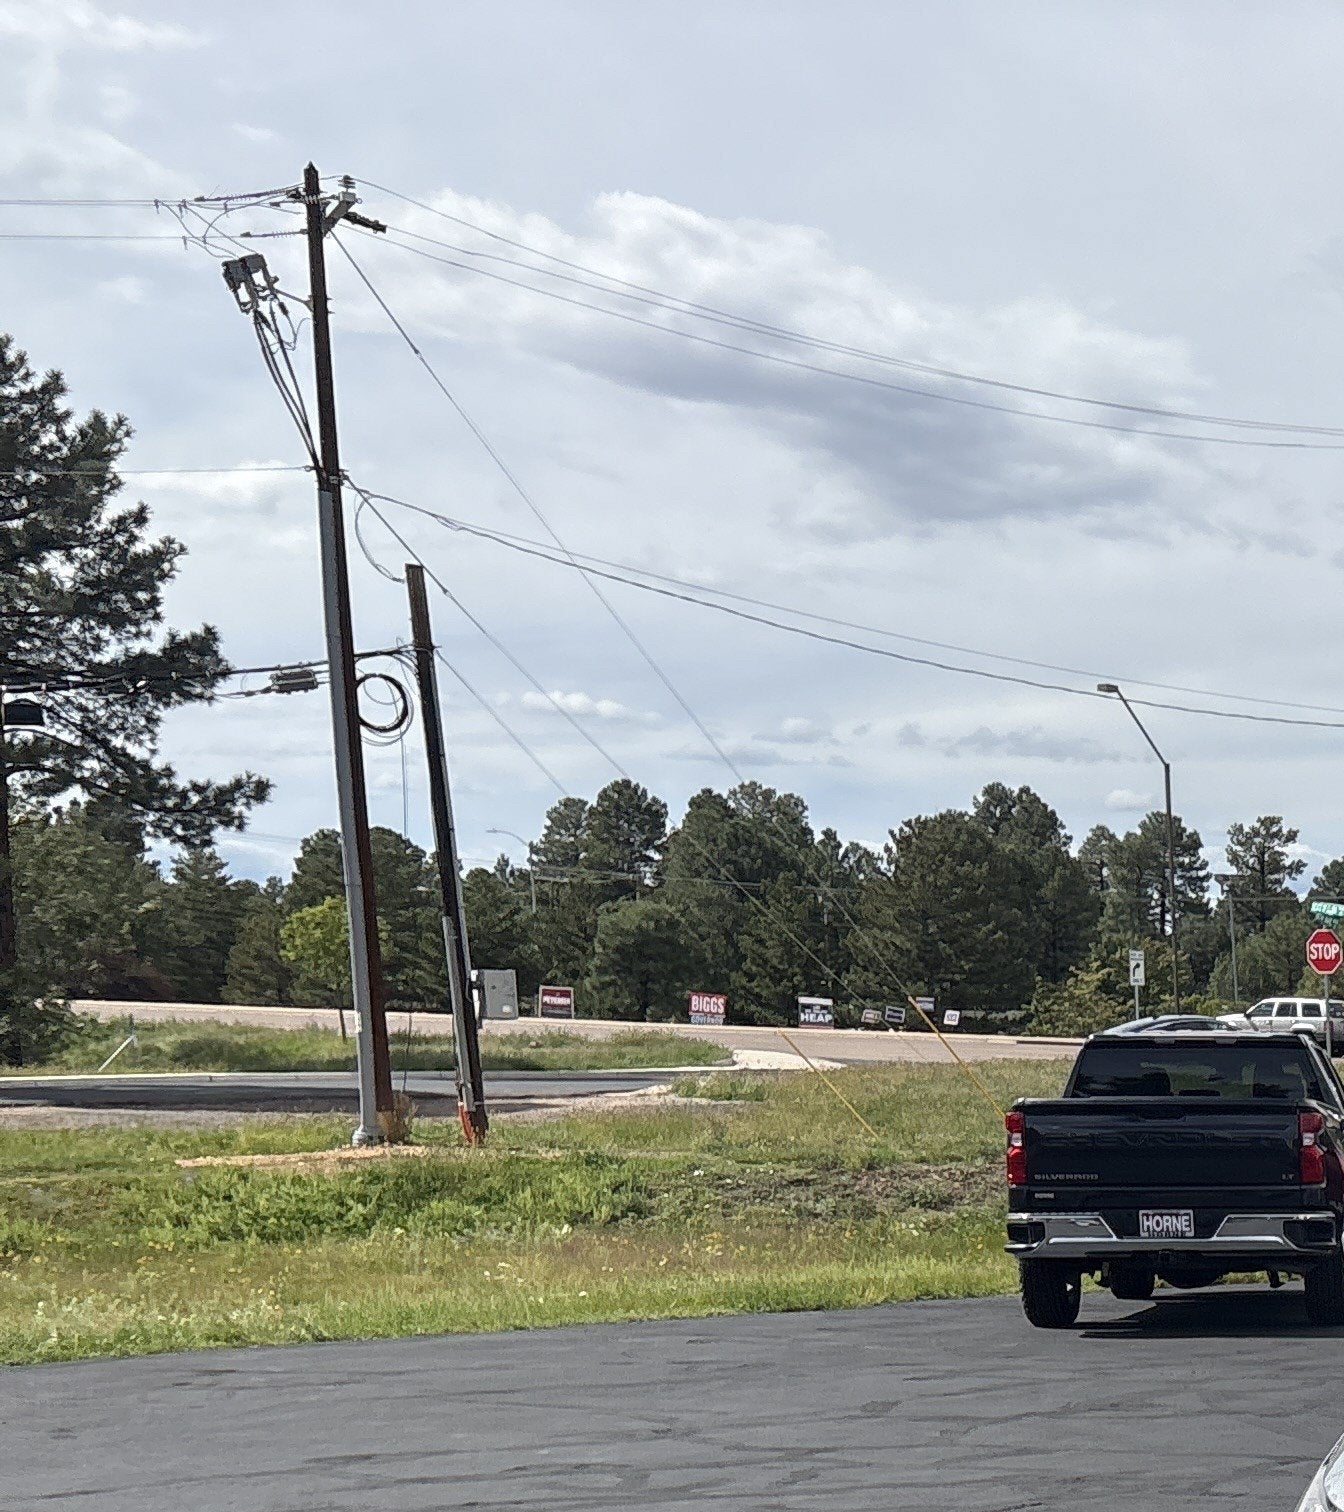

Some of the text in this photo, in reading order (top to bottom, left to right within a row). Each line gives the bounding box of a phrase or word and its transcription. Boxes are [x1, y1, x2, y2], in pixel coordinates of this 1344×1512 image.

[1310, 943, 1339, 960] STOP
[691, 995, 725, 1014] BIGGS
[800, 1012, 833, 1023] HEAP
[1143, 1215, 1191, 1232] HORNE
